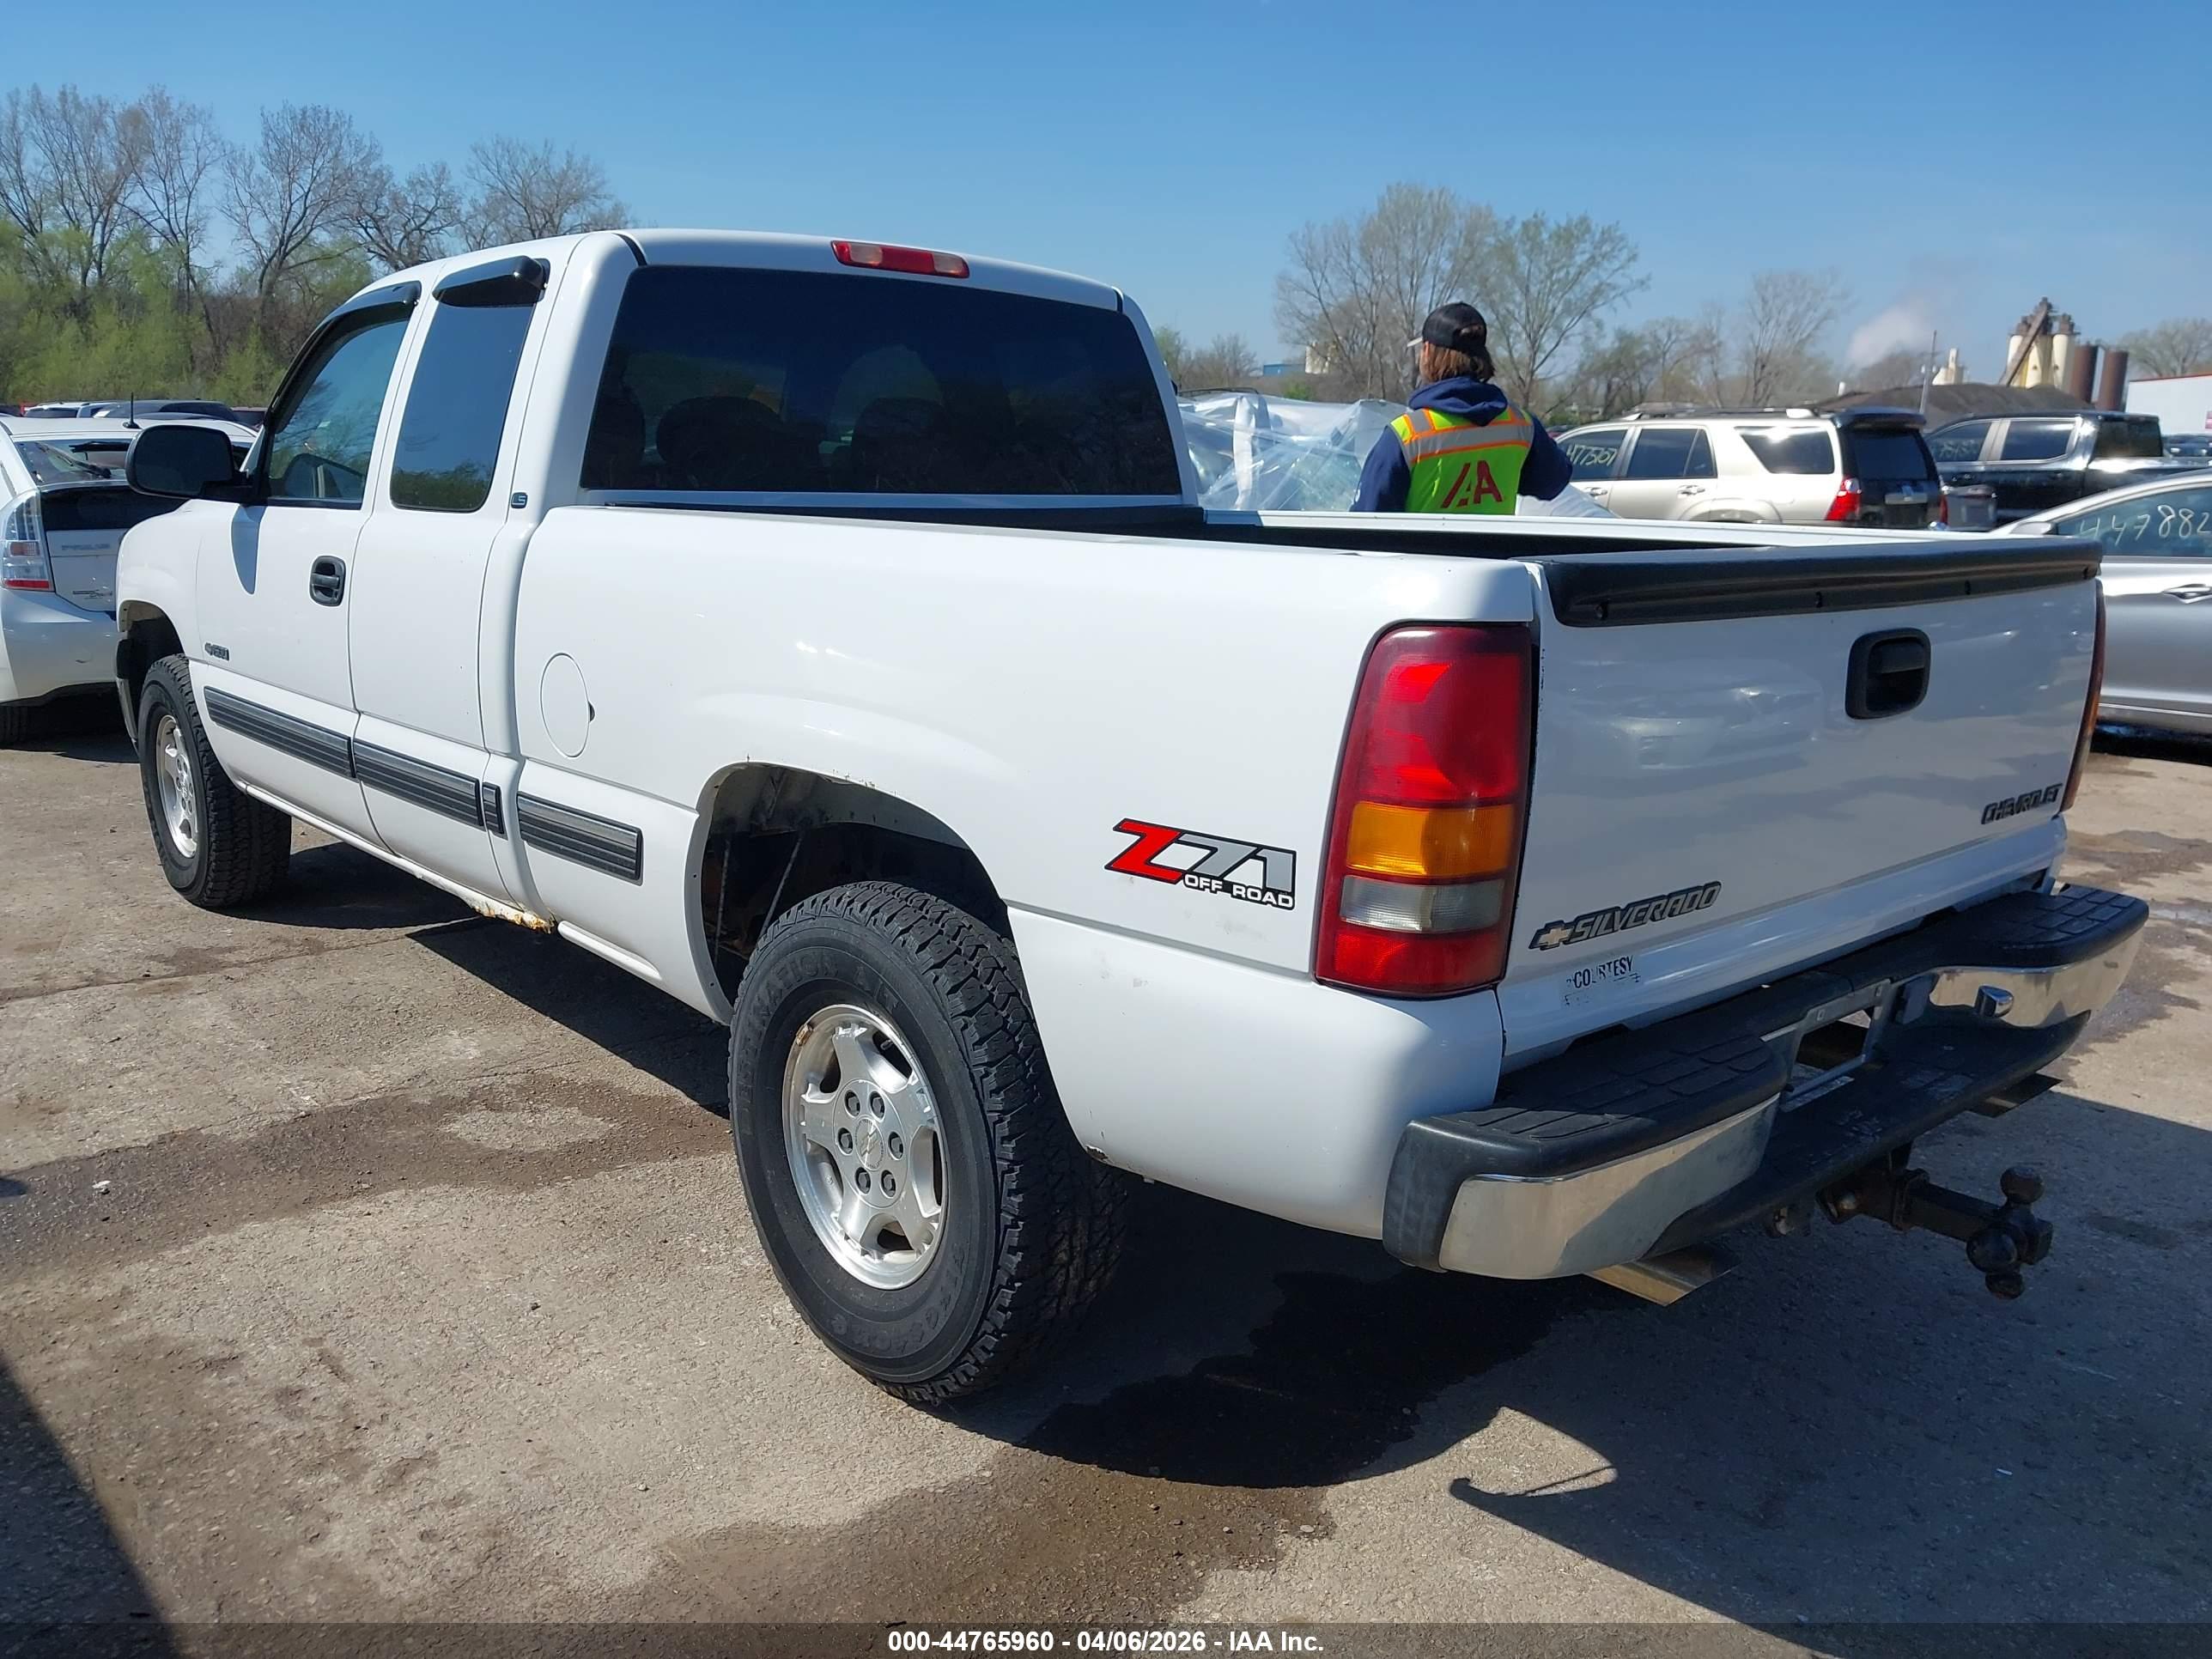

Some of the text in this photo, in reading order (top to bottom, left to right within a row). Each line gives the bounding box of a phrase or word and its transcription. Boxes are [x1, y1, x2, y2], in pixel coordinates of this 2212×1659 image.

[512, 494, 527, 506] LS
[1981, 782, 2063, 825] CHEVROLET
[1104, 817, 1297, 895] Z71
[1183, 873, 1295, 909] OFF ROAD
[1566, 881, 1723, 945] SILVERADO
